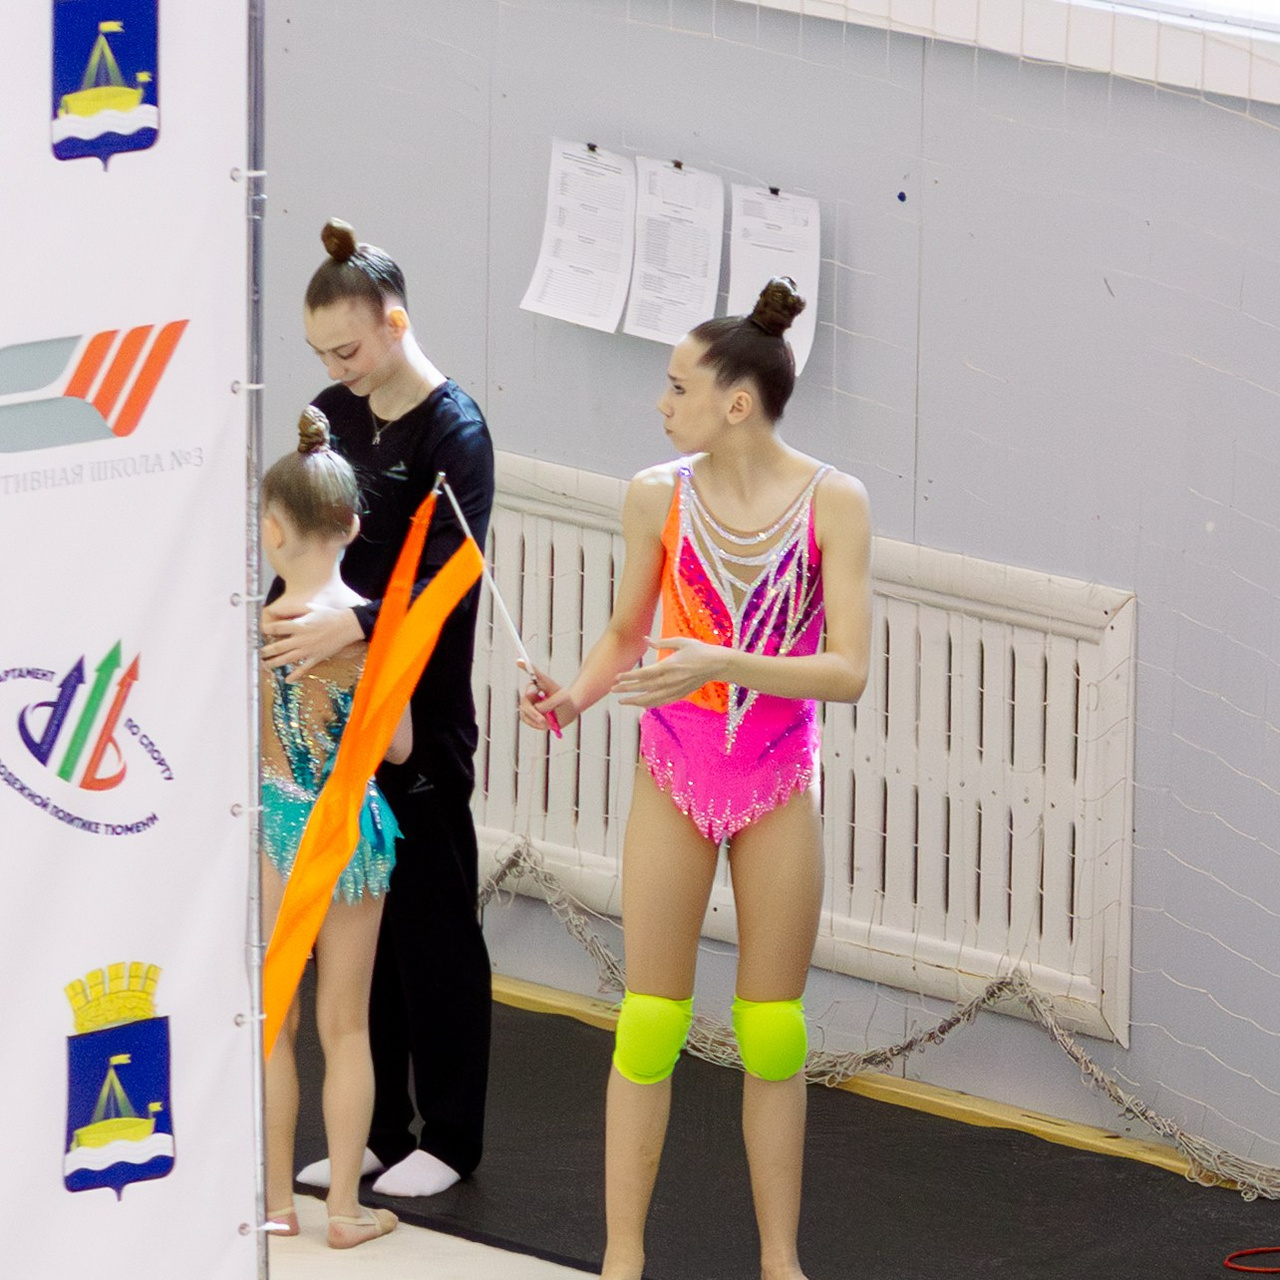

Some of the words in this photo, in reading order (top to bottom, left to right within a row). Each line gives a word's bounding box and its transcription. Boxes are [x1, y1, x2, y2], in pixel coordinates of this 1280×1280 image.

[90, 452, 165, 483] ШКОЛА
[171, 446, 205, 471] №3
[124, 717, 141, 736] ПО
[138, 733, 175, 781] СПОРТУ
[49, 804, 101, 834] ПОЛИТИКЕ
[104, 811, 160, 836] ТЮМЕНИ
